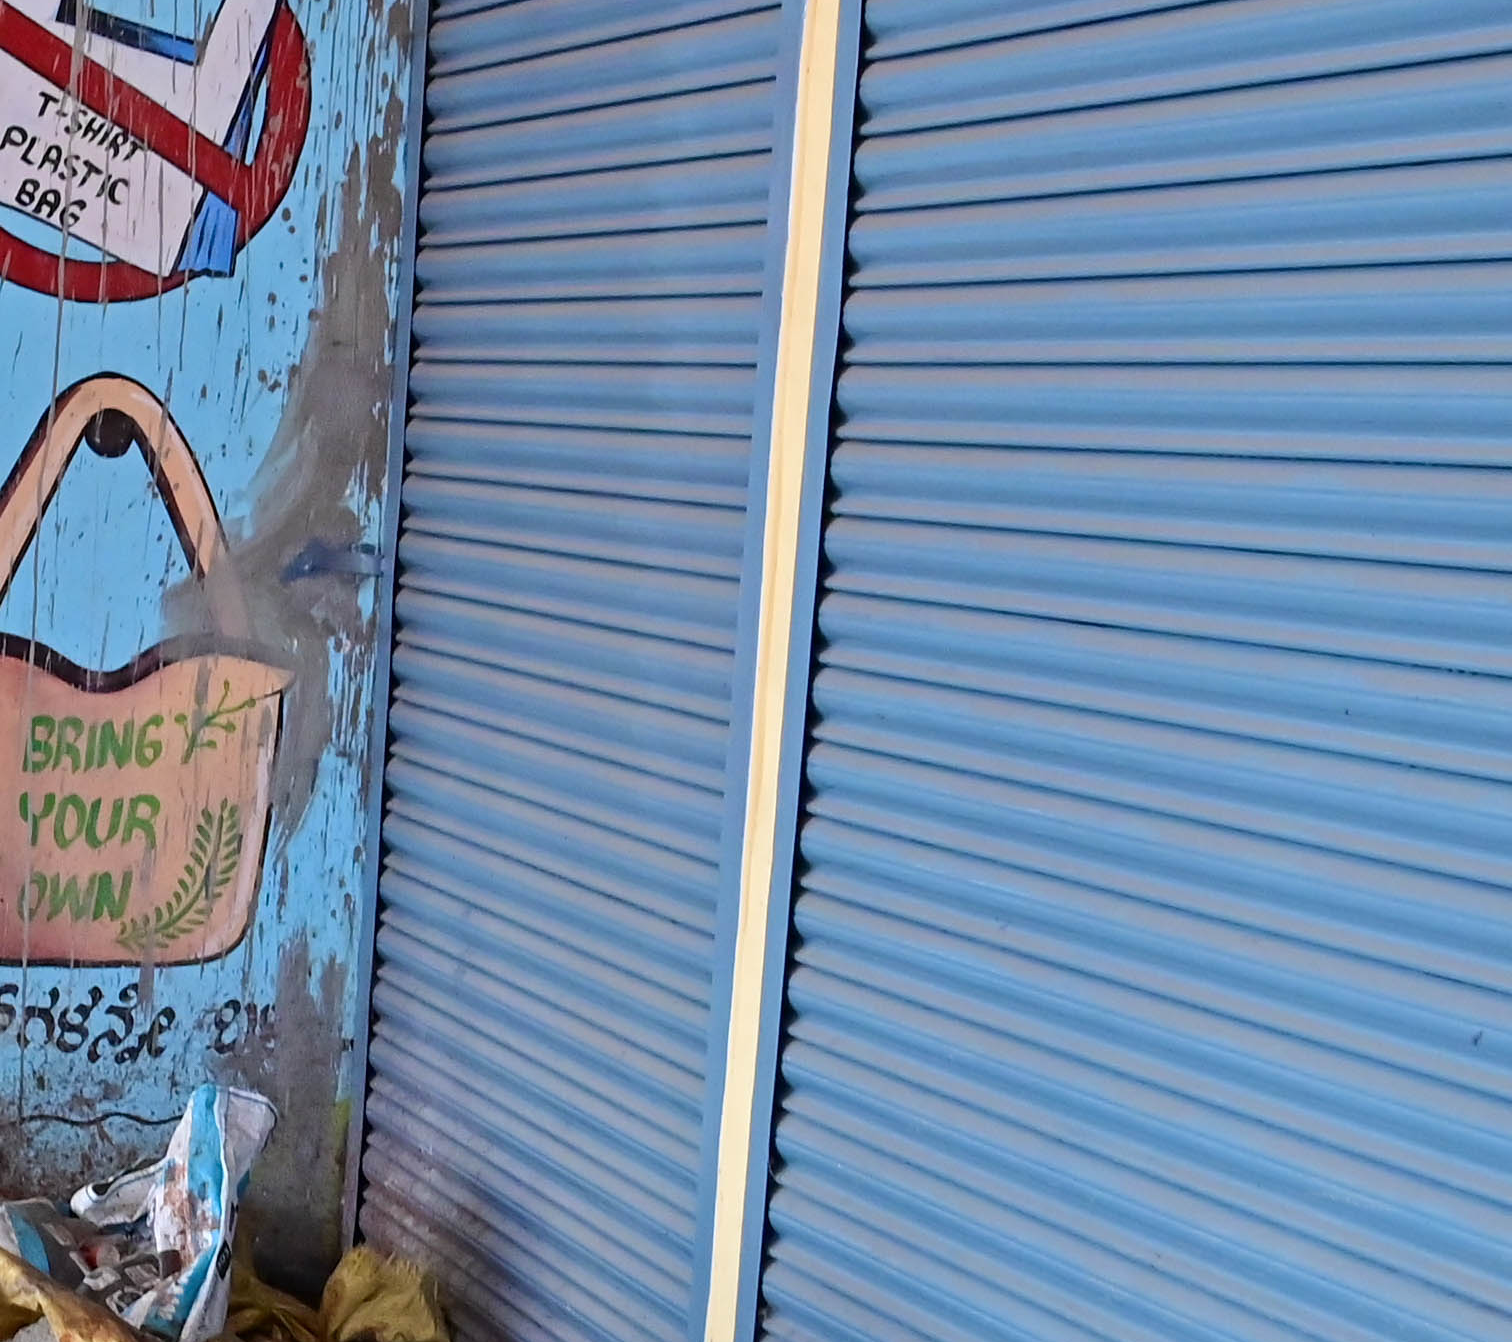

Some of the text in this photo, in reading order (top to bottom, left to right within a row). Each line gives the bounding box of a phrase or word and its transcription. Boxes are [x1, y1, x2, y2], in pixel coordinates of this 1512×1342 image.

[37, 91, 147, 162] T-SHIRT
[14, 178, 88, 228] BAG
[20, 713, 165, 775] BRING
[18, 791, 162, 852] YOUR
[17, 868, 134, 923] OWN
